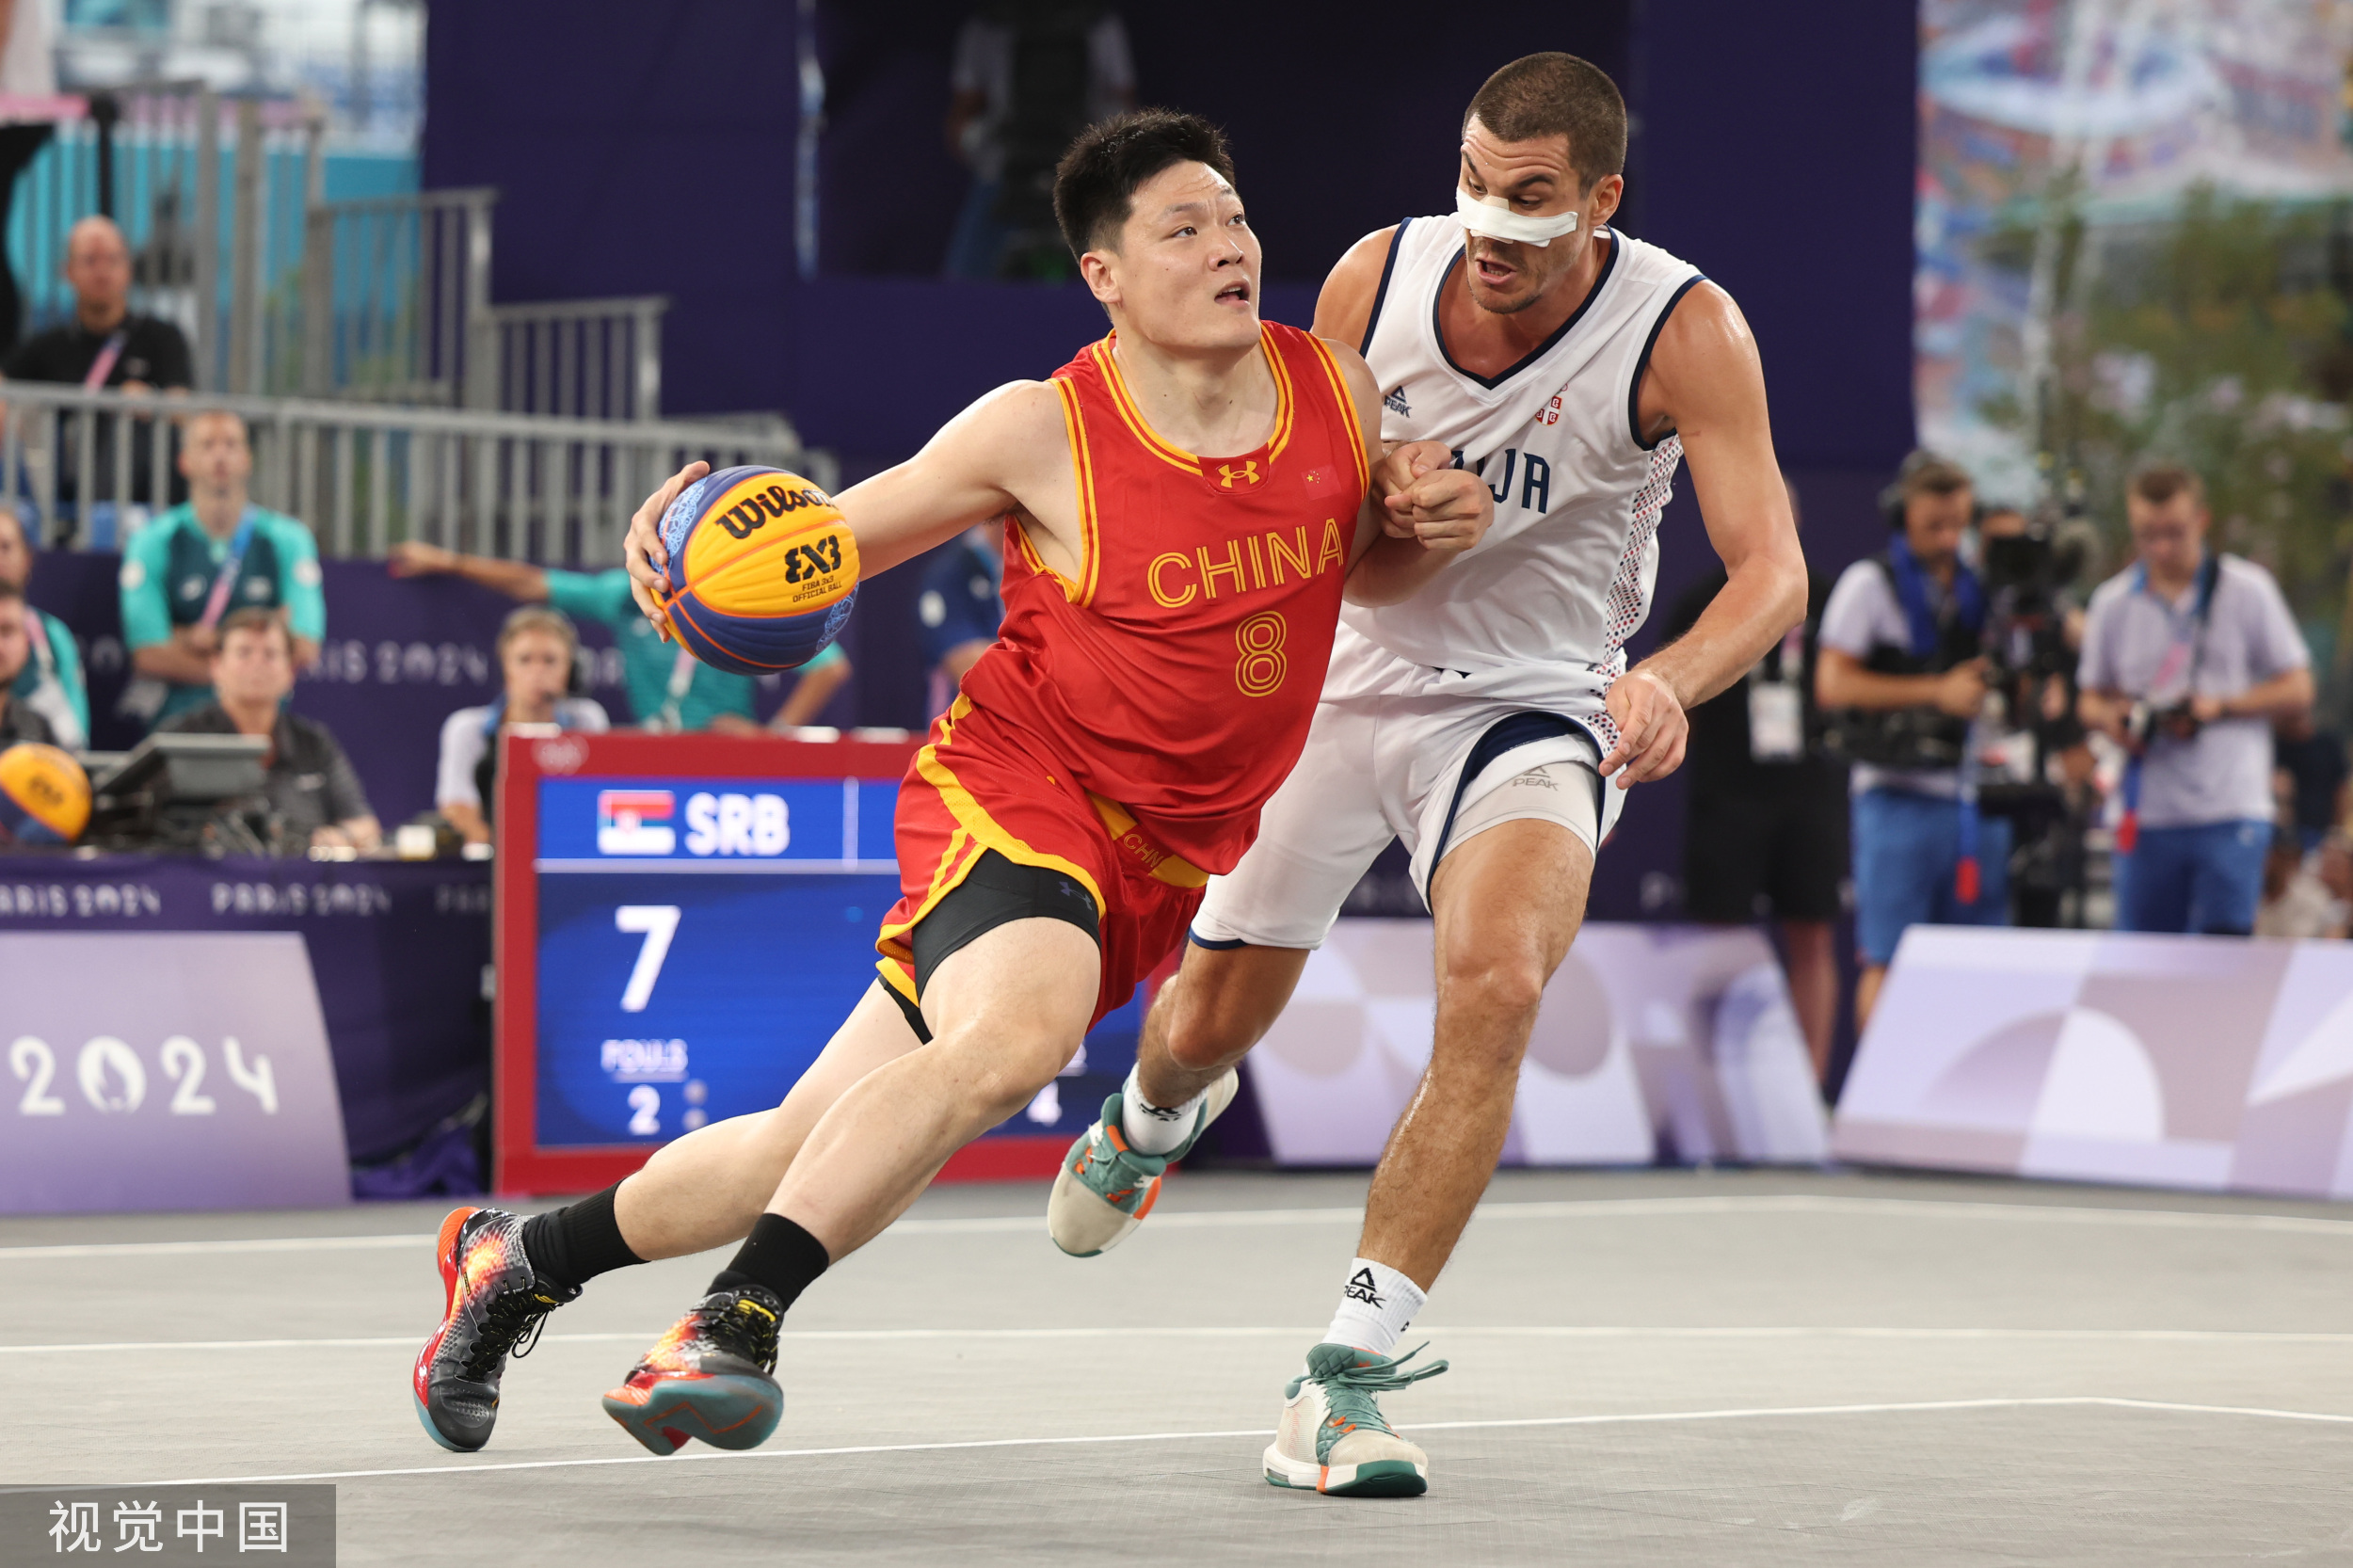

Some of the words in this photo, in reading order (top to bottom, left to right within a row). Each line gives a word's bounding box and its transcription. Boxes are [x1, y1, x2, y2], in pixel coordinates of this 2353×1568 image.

[1384, 394, 1413, 419] PEAK
[714, 485, 840, 540] Wilson
[802, 580, 821, 592] FIBA
[822, 575, 834, 586] 3x3
[1146, 517, 1344, 608] CHINA
[792, 586, 827, 603] OFFICIAL
[827, 581, 842, 593] BALL
[1234, 610, 1288, 697] 8
[1512, 777, 1560, 792] PEAK
[684, 792, 792, 856] SRB
[1123, 833, 1164, 868] CHN
[616, 904, 682, 1014] 7
[627, 1083, 662, 1135] 2
